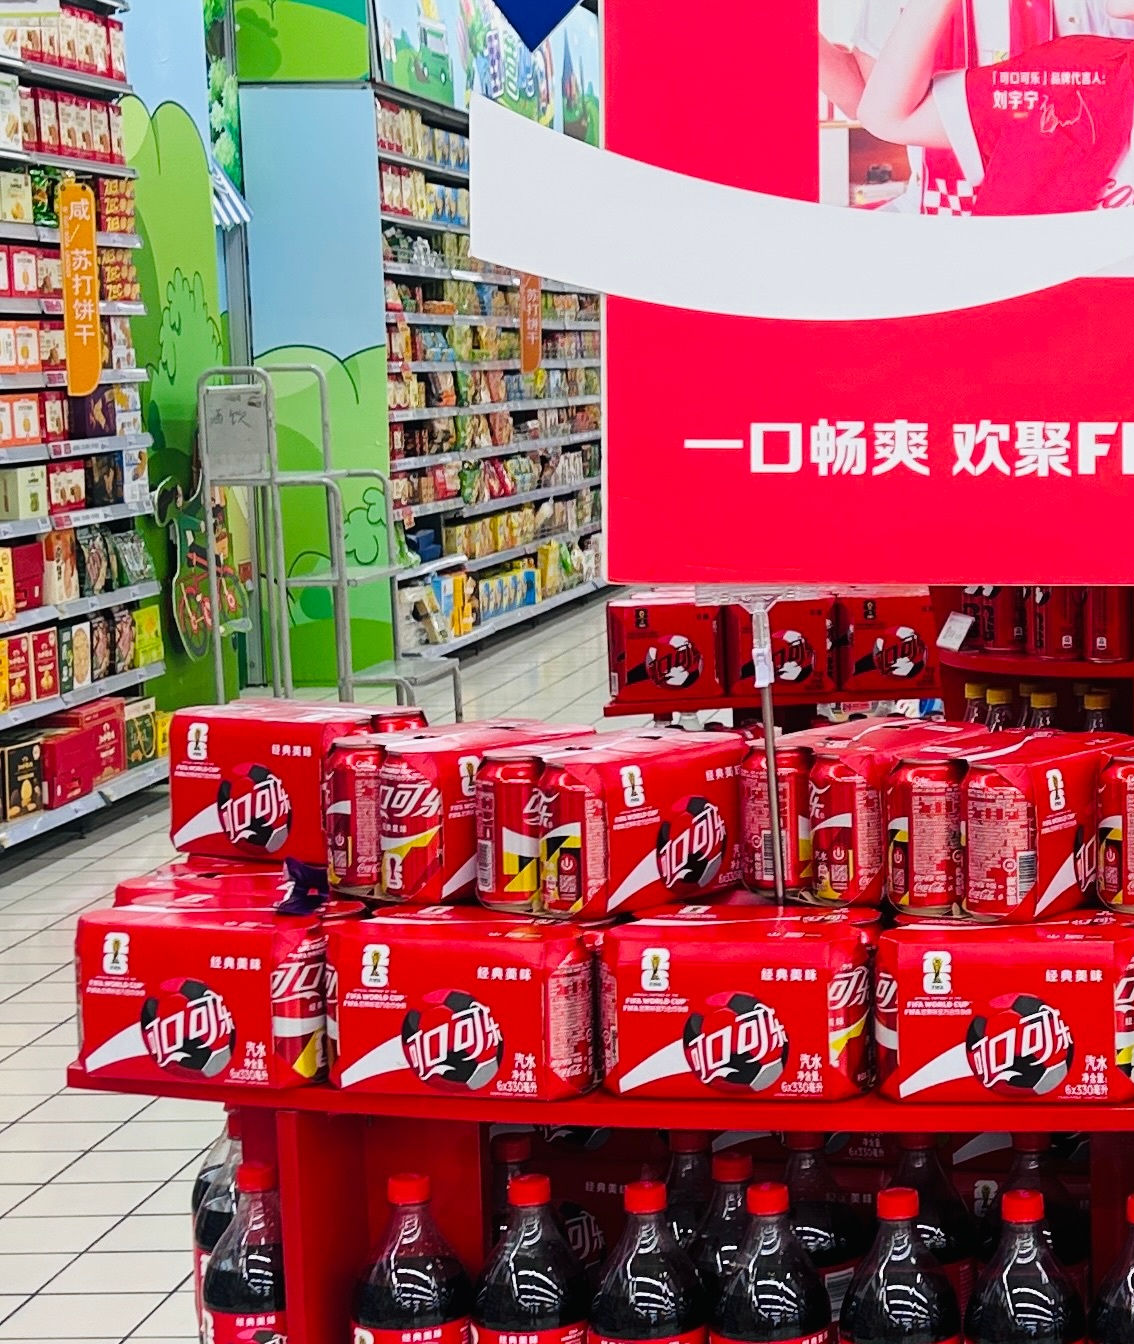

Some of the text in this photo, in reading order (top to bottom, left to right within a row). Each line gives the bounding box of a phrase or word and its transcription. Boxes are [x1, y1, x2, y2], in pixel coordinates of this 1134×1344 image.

[993, 90, 1039, 110] 刘宇宁
[684, 419, 930, 476] 一口畅爽
[210, 956, 261, 971] 经典美味
[477, 967, 532, 981] 经典美味
[761, 968, 817, 982] 经典美味
[1046, 969, 1103, 983] 经典美味
[246, 1042, 266, 1057] 汽水
[515, 1053, 536, 1068] 汽水
[800, 1054, 823, 1068] 汽水
[1085, 1055, 1108, 1070] 汽水
